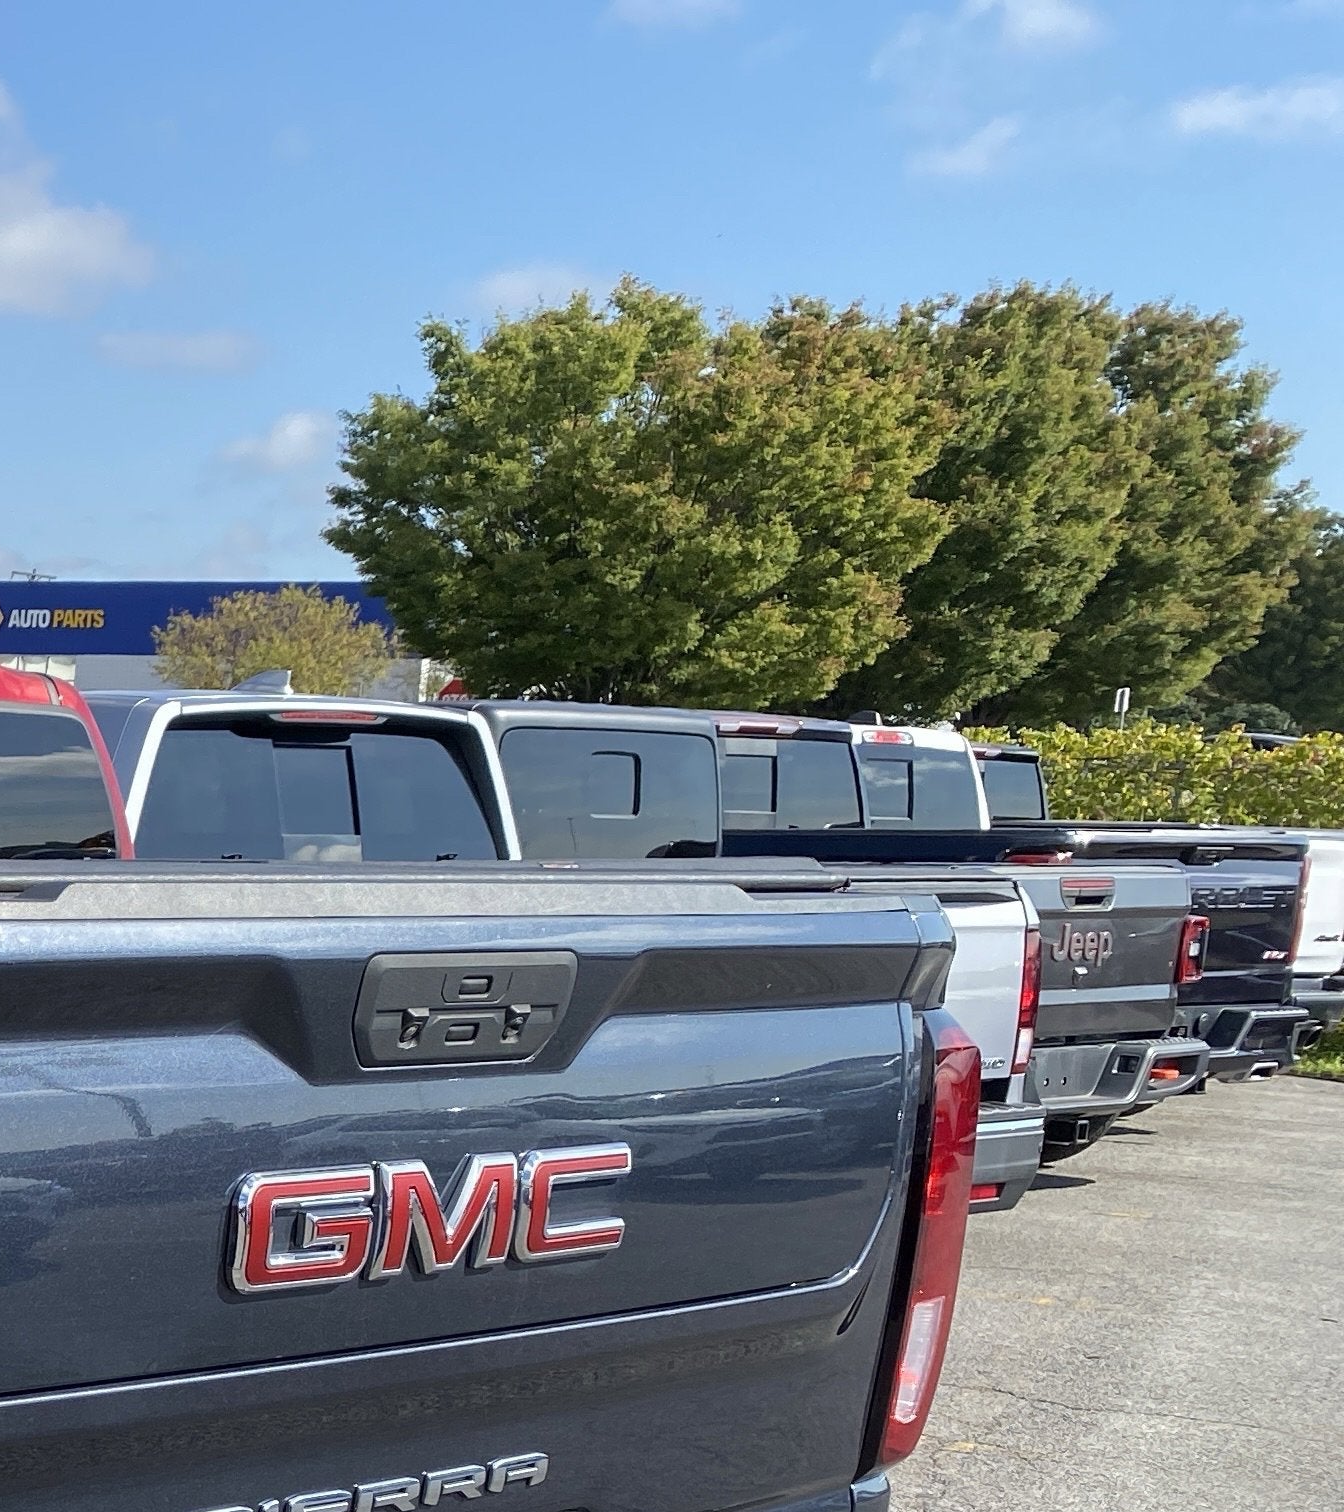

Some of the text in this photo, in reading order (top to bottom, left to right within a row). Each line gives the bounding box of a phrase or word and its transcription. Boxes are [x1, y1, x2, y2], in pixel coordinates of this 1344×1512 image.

[8, 609, 51, 628] AUTO
[52, 609, 105, 628] PARTS
[1052, 922, 1113, 968] Jeep
[228, 1141, 632, 1295] GMC
